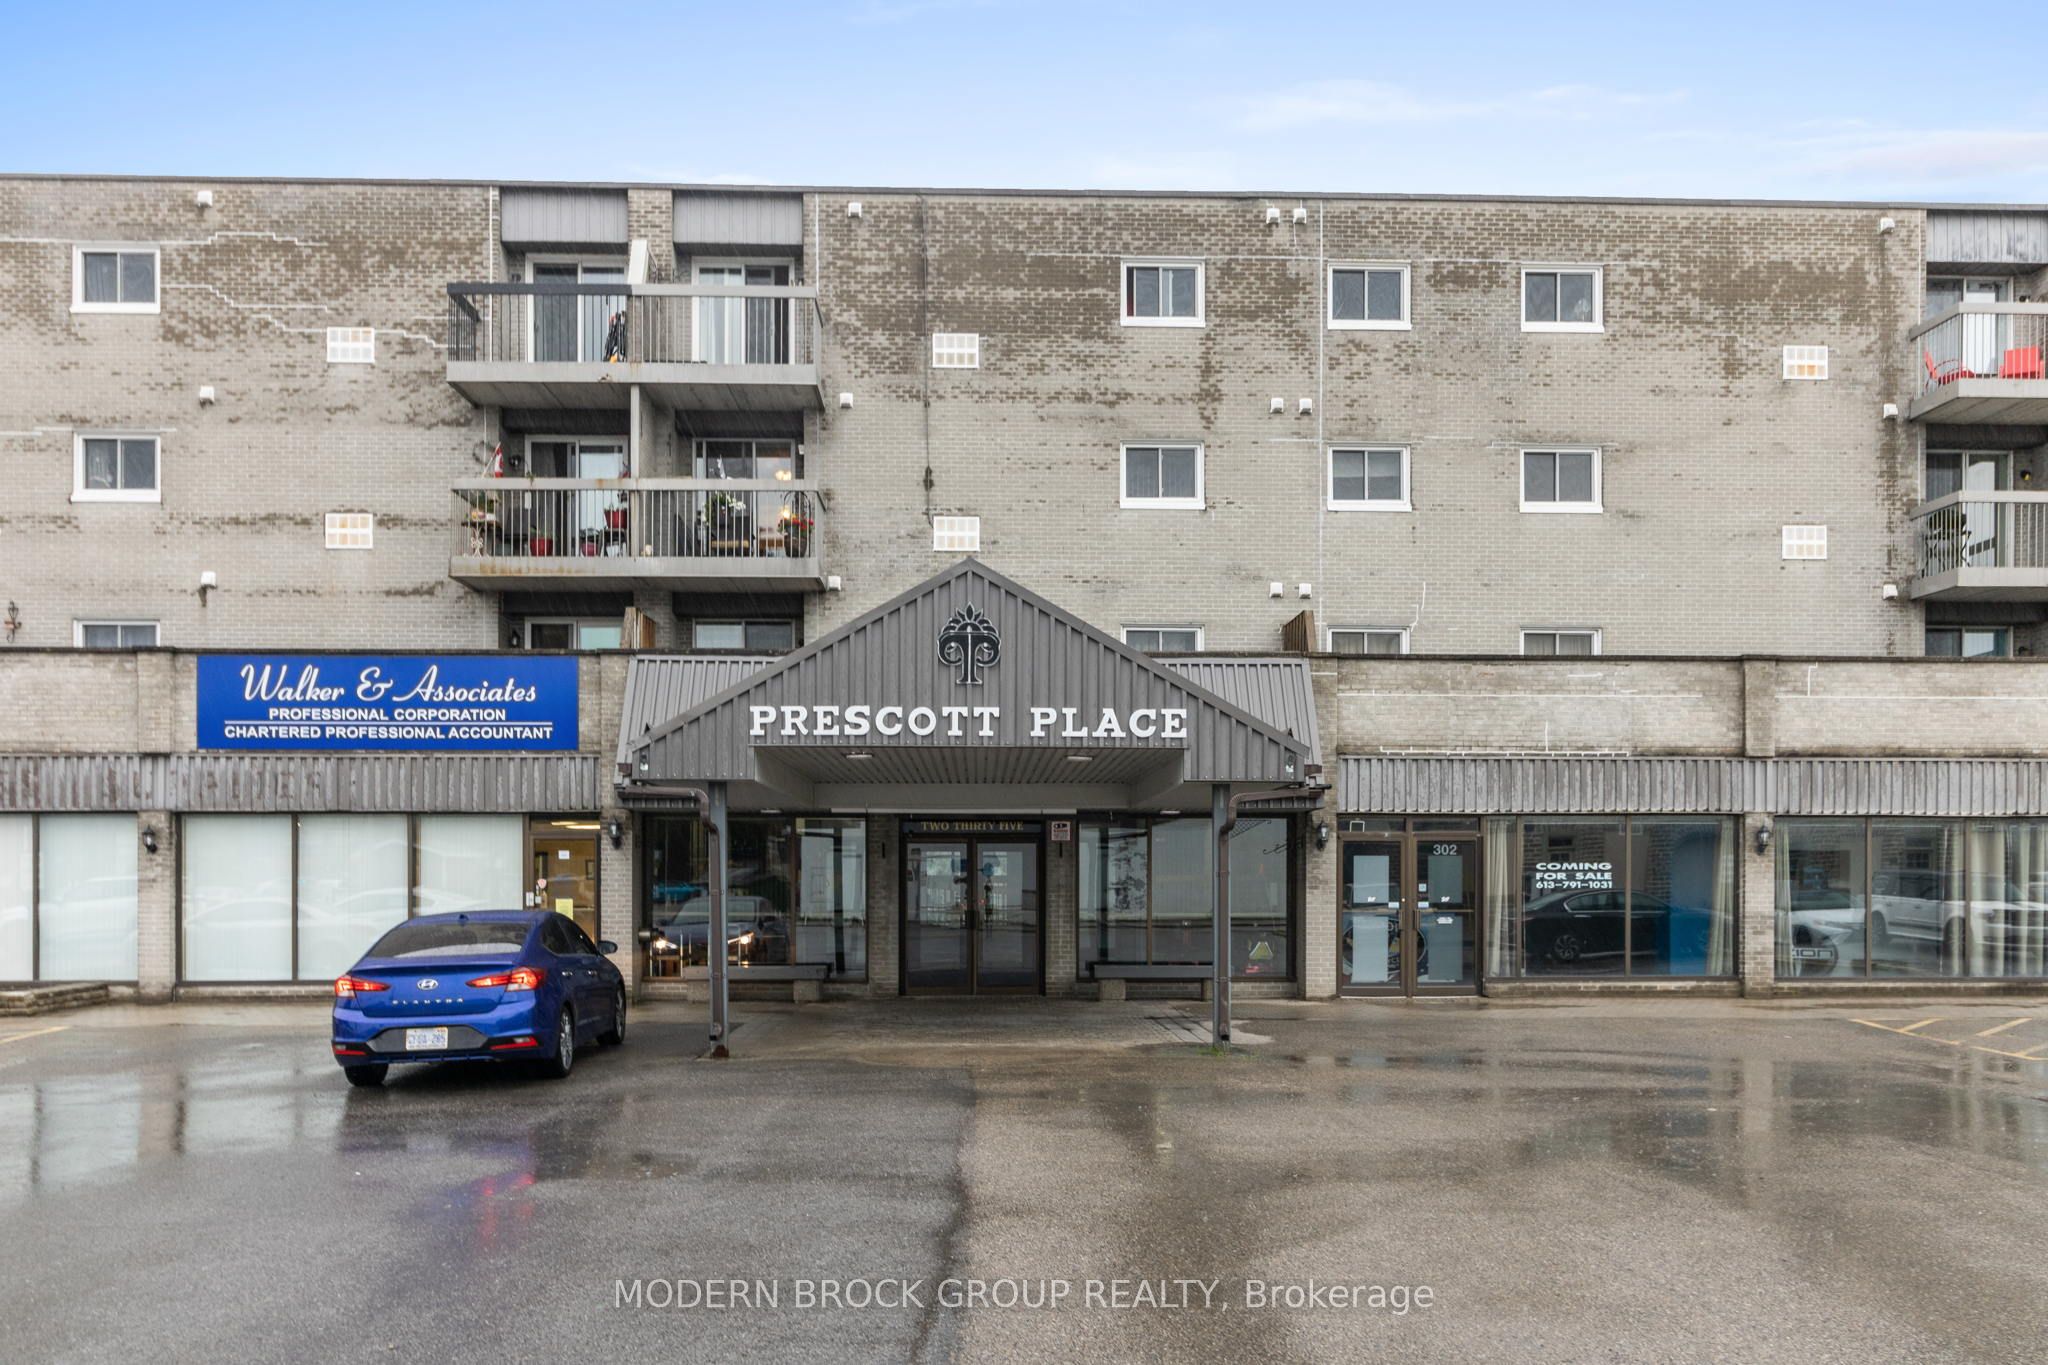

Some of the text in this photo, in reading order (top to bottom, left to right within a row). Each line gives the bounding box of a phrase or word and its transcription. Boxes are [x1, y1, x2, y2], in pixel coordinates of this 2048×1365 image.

[240, 663, 536, 702] Walker & Associates
[269, 707, 506, 721] PROFESSIONAL CORPORATION
[749, 704, 1188, 739] PRESCOTT PLACE
[224, 725, 553, 739] CHARTERED PROFESSIONAL ACCOUNTANT
[920, 820, 1024, 832] TWO THIRTY FIVE
[1433, 844, 1457, 855] 302
[1535, 862, 1613, 870] COMING
[1535, 872, 1613, 880] FOR SALE
[1535, 881, 1613, 889] 613-791-1031
